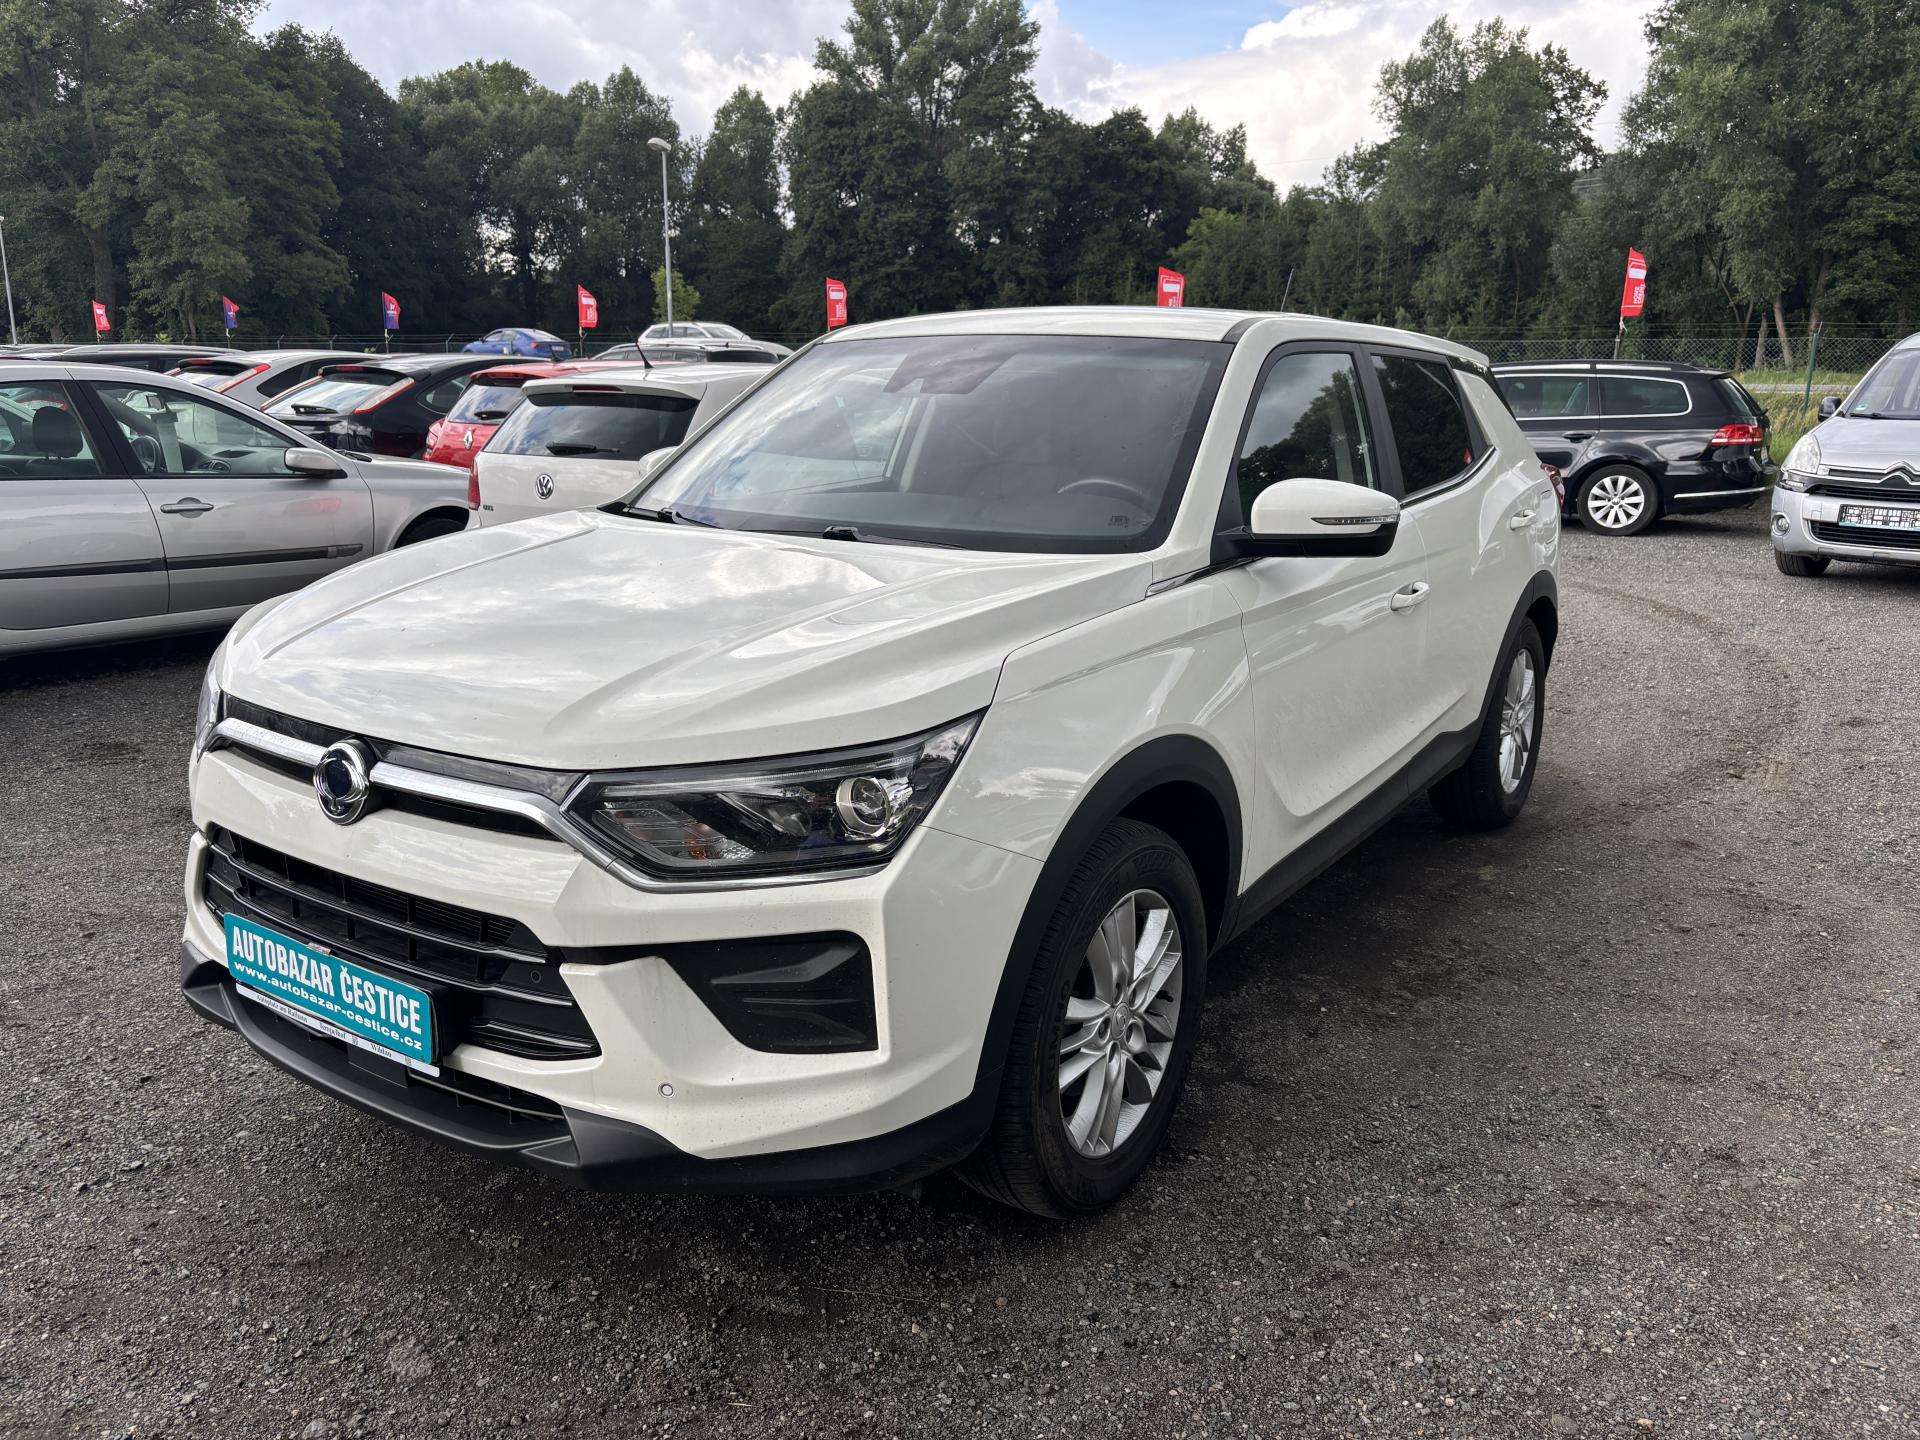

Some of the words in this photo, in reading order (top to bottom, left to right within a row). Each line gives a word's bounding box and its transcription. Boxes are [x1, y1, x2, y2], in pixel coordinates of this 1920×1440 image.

[233, 926, 334, 997] AUTOBAZAR
[339, 965, 422, 1035] ČESTICE
[234, 962, 422, 1050] www.autobazar-cestice.cz
